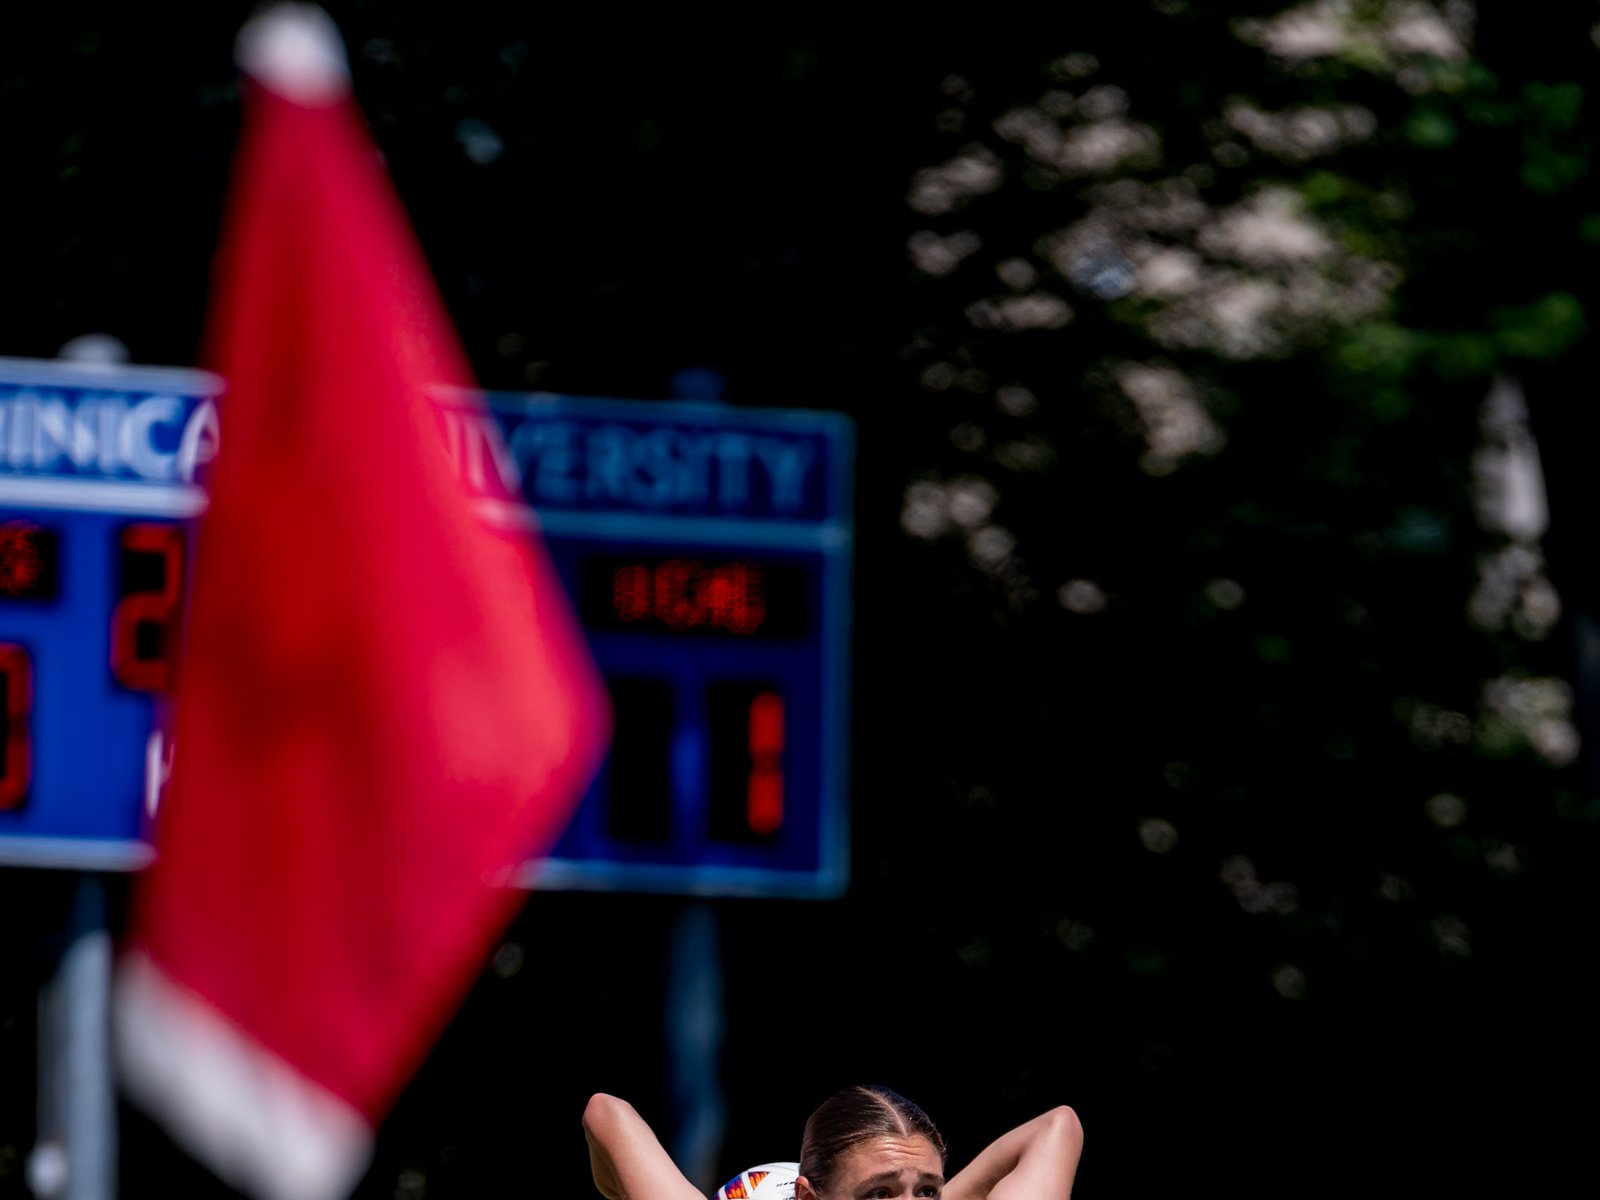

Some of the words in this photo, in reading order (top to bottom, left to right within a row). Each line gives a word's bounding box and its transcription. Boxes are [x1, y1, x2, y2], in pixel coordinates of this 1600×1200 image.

[0, 393, 219, 481] INICA
[111, 522, 183, 692] 2
[746, 691, 786, 835] 1
